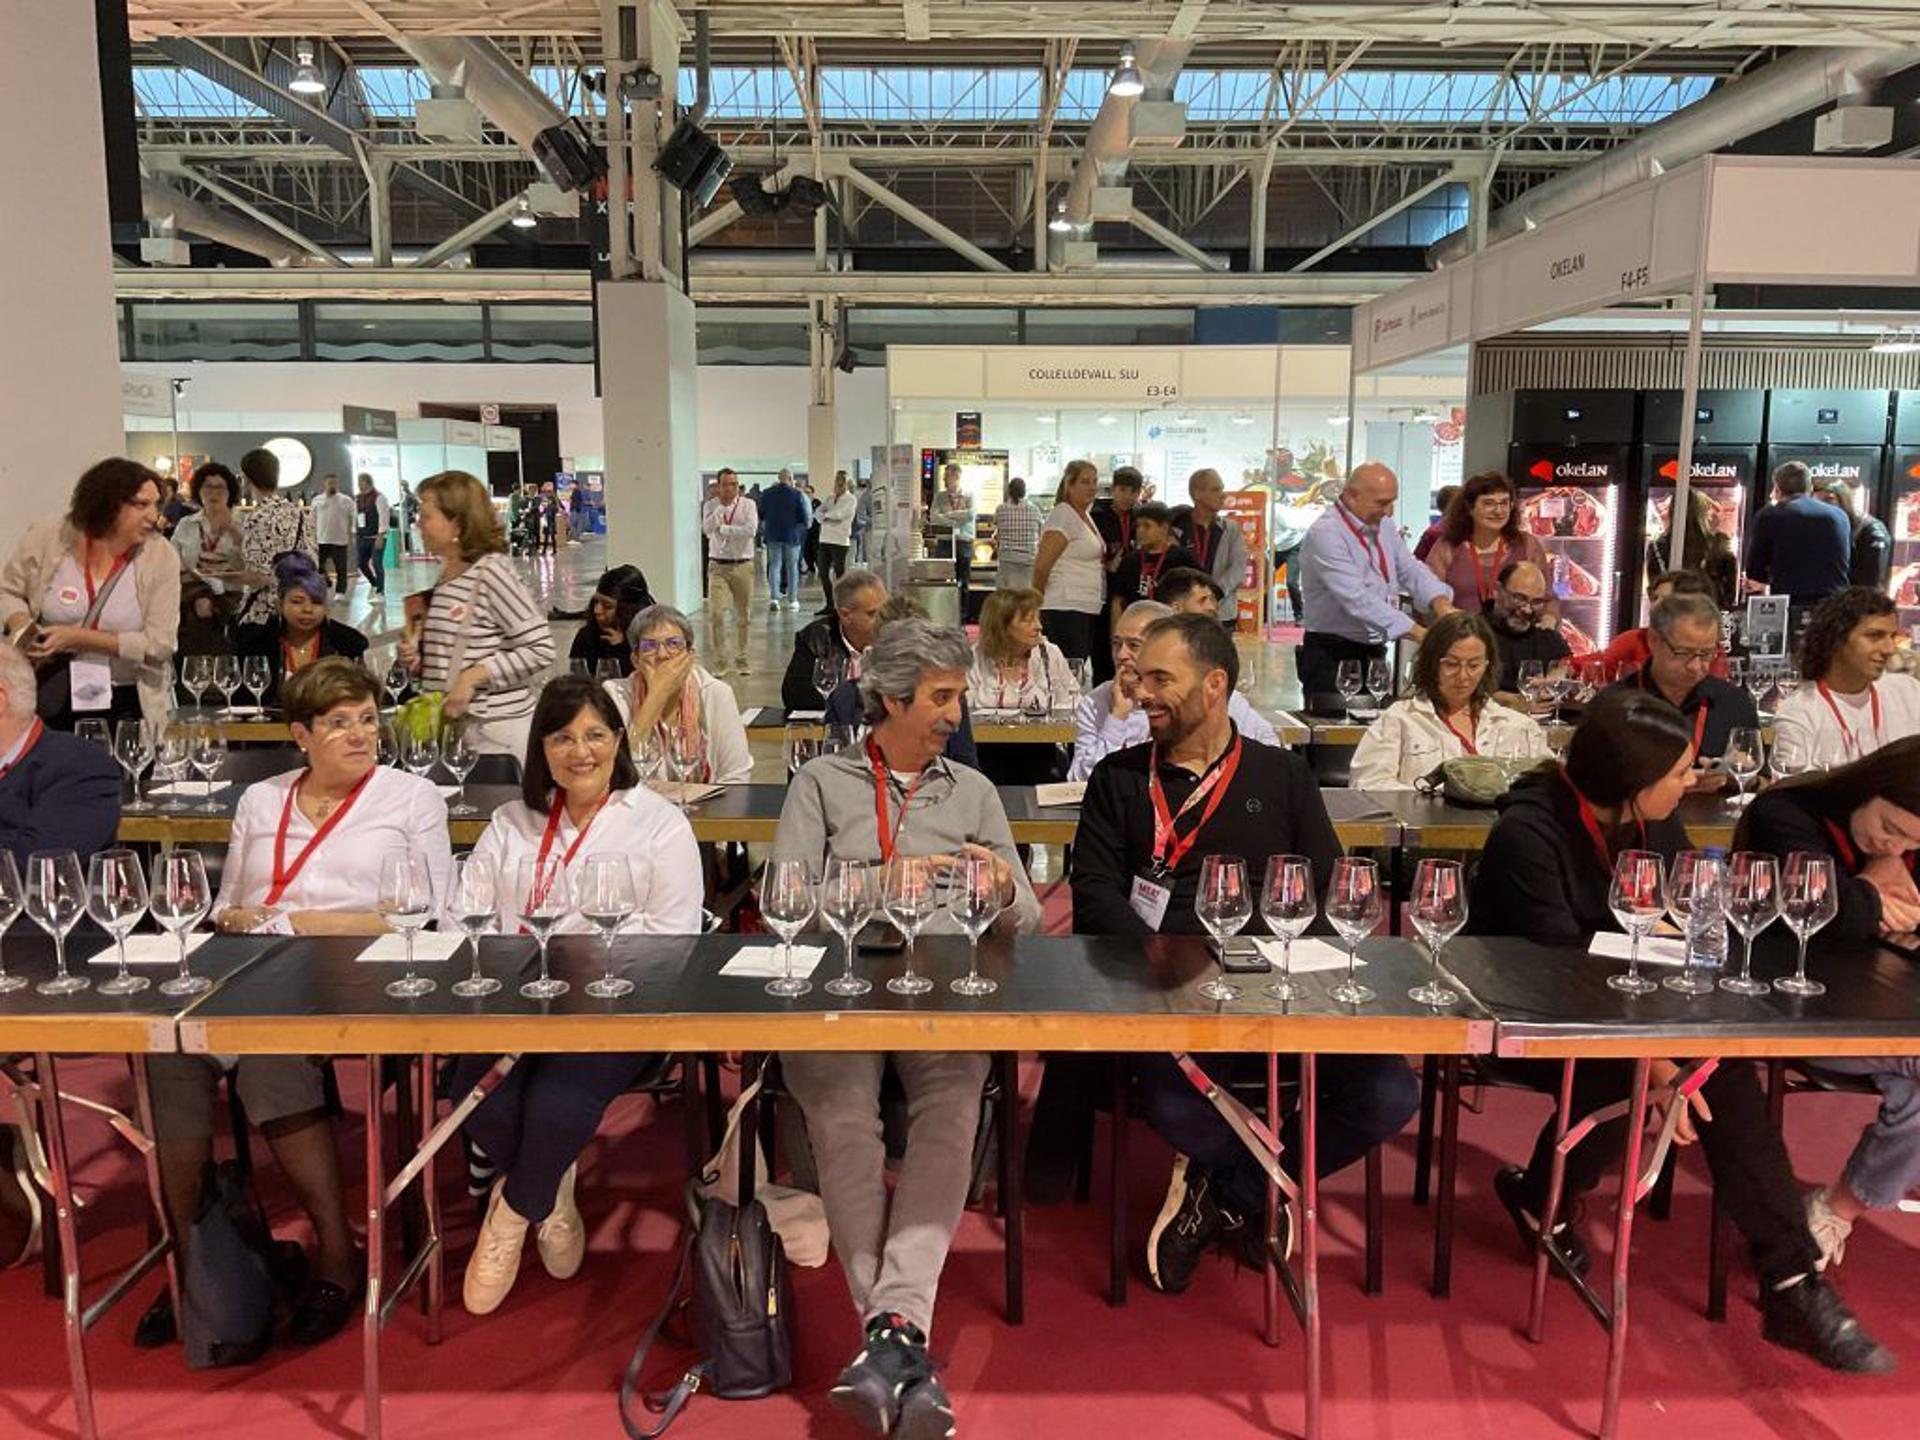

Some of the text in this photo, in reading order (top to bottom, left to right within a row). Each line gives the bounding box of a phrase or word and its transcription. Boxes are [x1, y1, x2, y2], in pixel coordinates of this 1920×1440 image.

[1550, 253, 1585, 280] OKELAN
[1620, 266, 1649, 291] F4-F5
[1119, 368, 1140, 380] SLU
[1146, 385, 1177, 397] E3-E4
